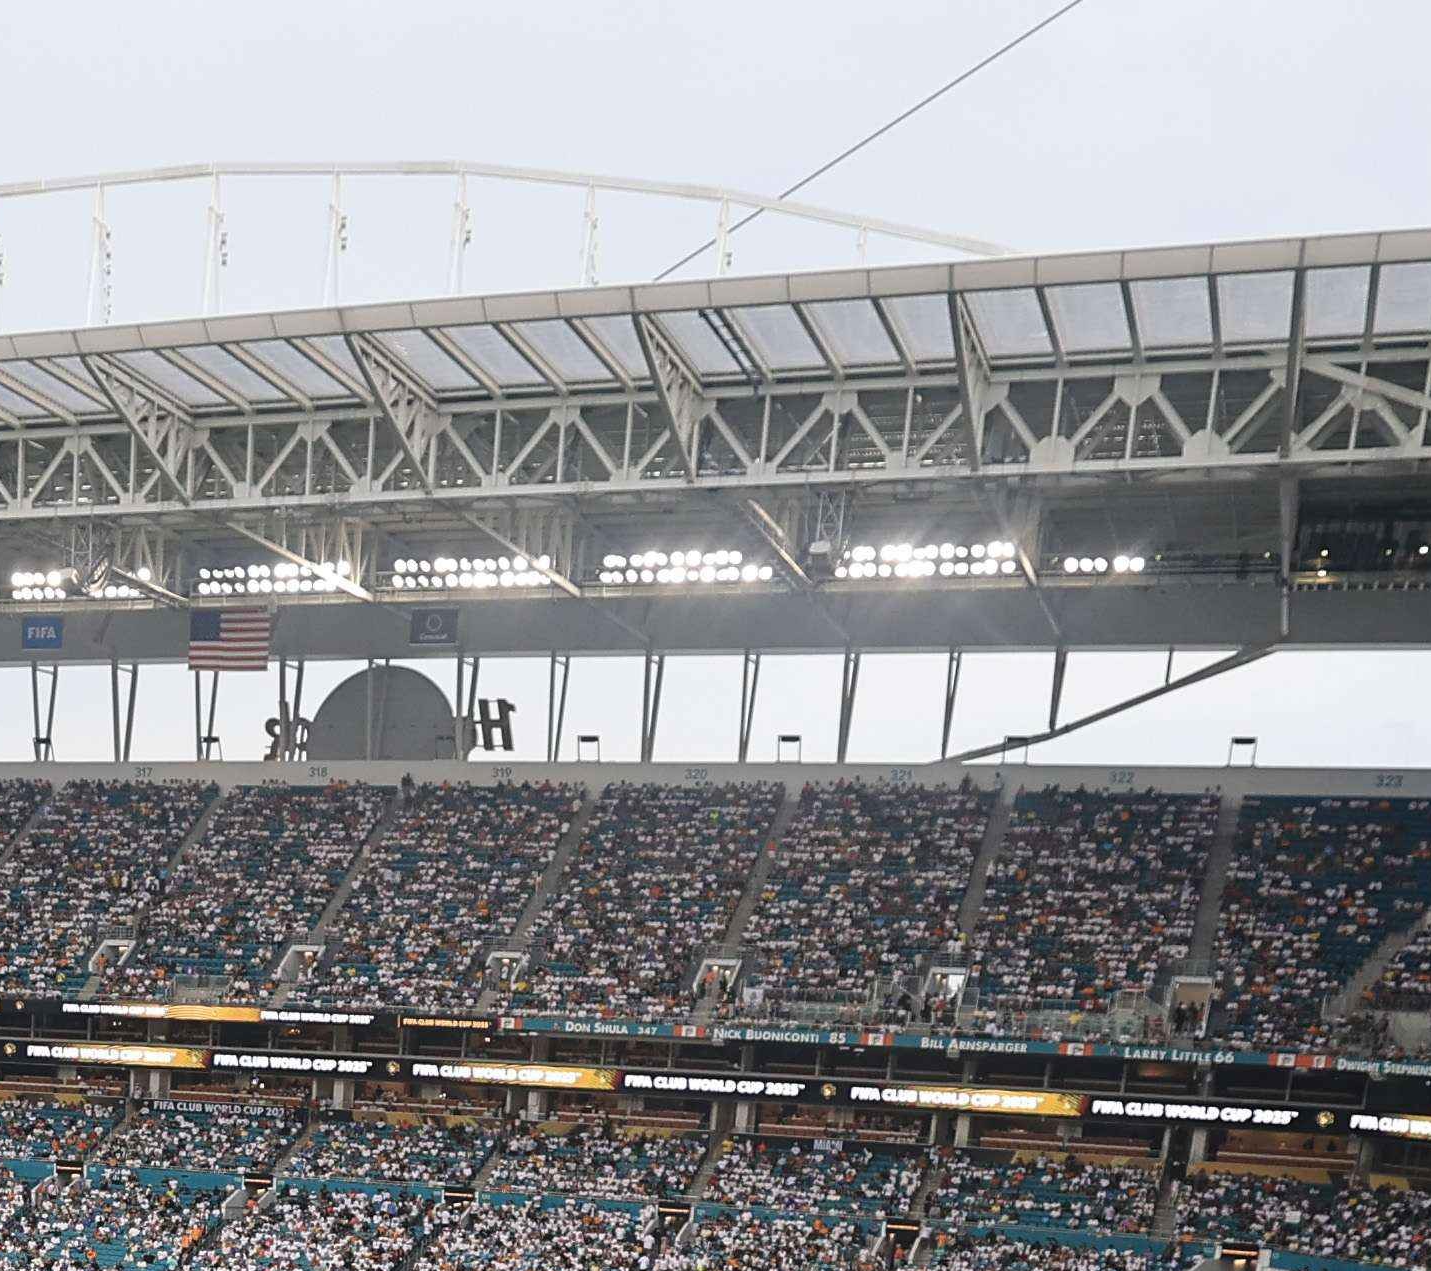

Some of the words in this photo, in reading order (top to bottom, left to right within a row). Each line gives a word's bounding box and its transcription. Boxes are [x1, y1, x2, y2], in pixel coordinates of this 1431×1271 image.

[27, 627, 57, 639] FIFA
[135, 767, 152, 777] 317
[309, 767, 327, 777] 318
[493, 768, 511, 778] 319
[685, 769, 707, 779] 320
[891, 769, 912, 780] 321
[565, 1020, 591, 1033] DON
[593, 1021, 629, 1035] SHULA
[637, 1024, 657, 1035] 347
[713, 1027, 744, 1040] NICK
[746, 1028, 819, 1043] BUONICONTI
[829, 1032, 846, 1044] 85
[948, 1037, 1027, 1053] ARNSPARGER
[1123, 1047, 1167, 1060] LARRY
[1171, 1050, 1211, 1063] LITTLE
[1213, 1051, 1235, 1063] 66
